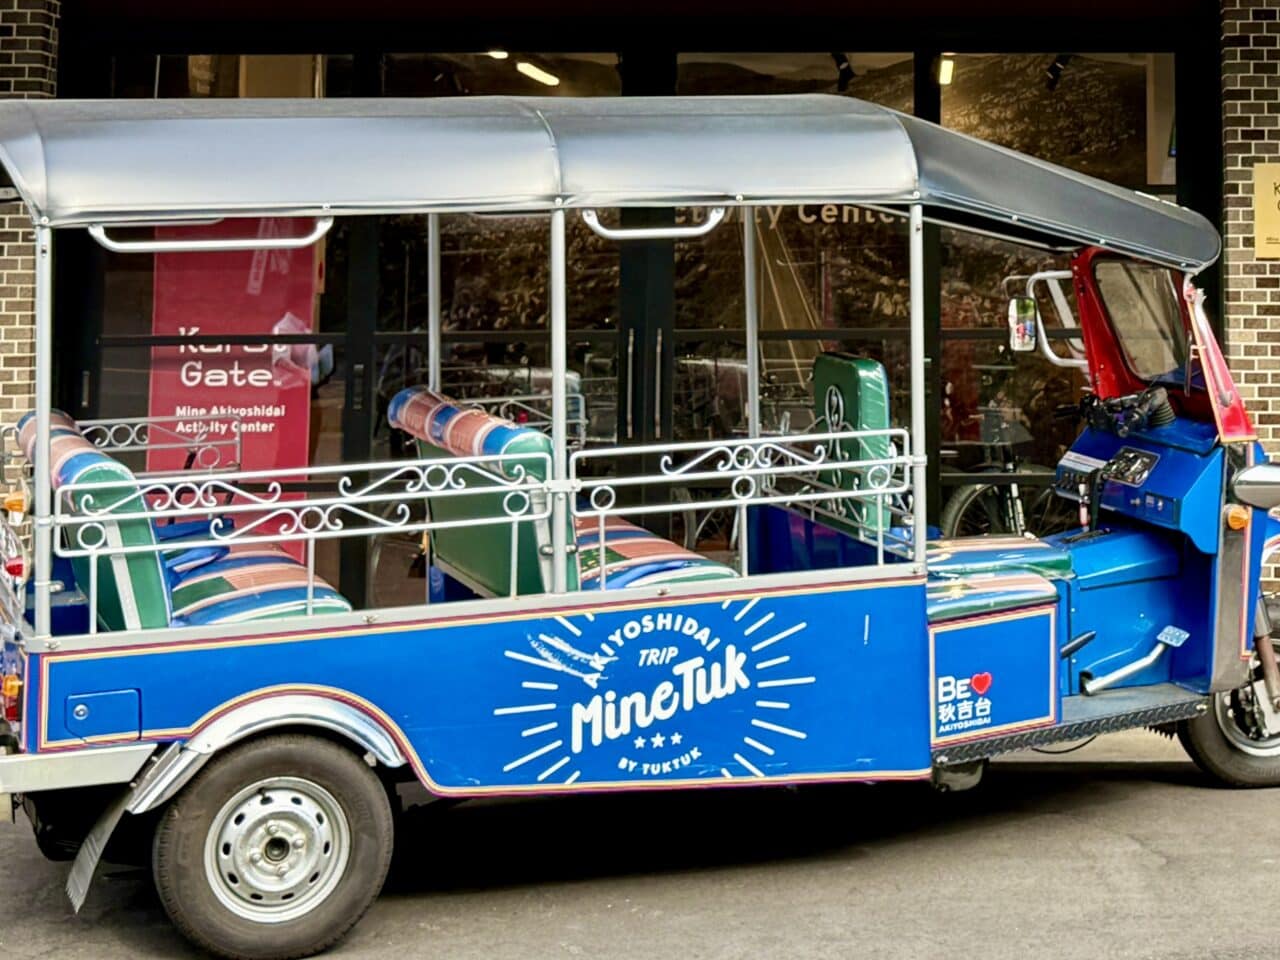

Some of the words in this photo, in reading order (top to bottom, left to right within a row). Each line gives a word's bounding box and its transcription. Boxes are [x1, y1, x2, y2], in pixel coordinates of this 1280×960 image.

[181, 361, 273, 386] Gate
[176, 406, 206, 416] Mine
[583, 613, 721, 689] AKIYOSHIDAI
[638, 646, 679, 667] TRIP
[938, 697, 992, 724] 秋吉台
[618, 757, 638, 772] BY
[642, 747, 702, 775] TUKTUK
